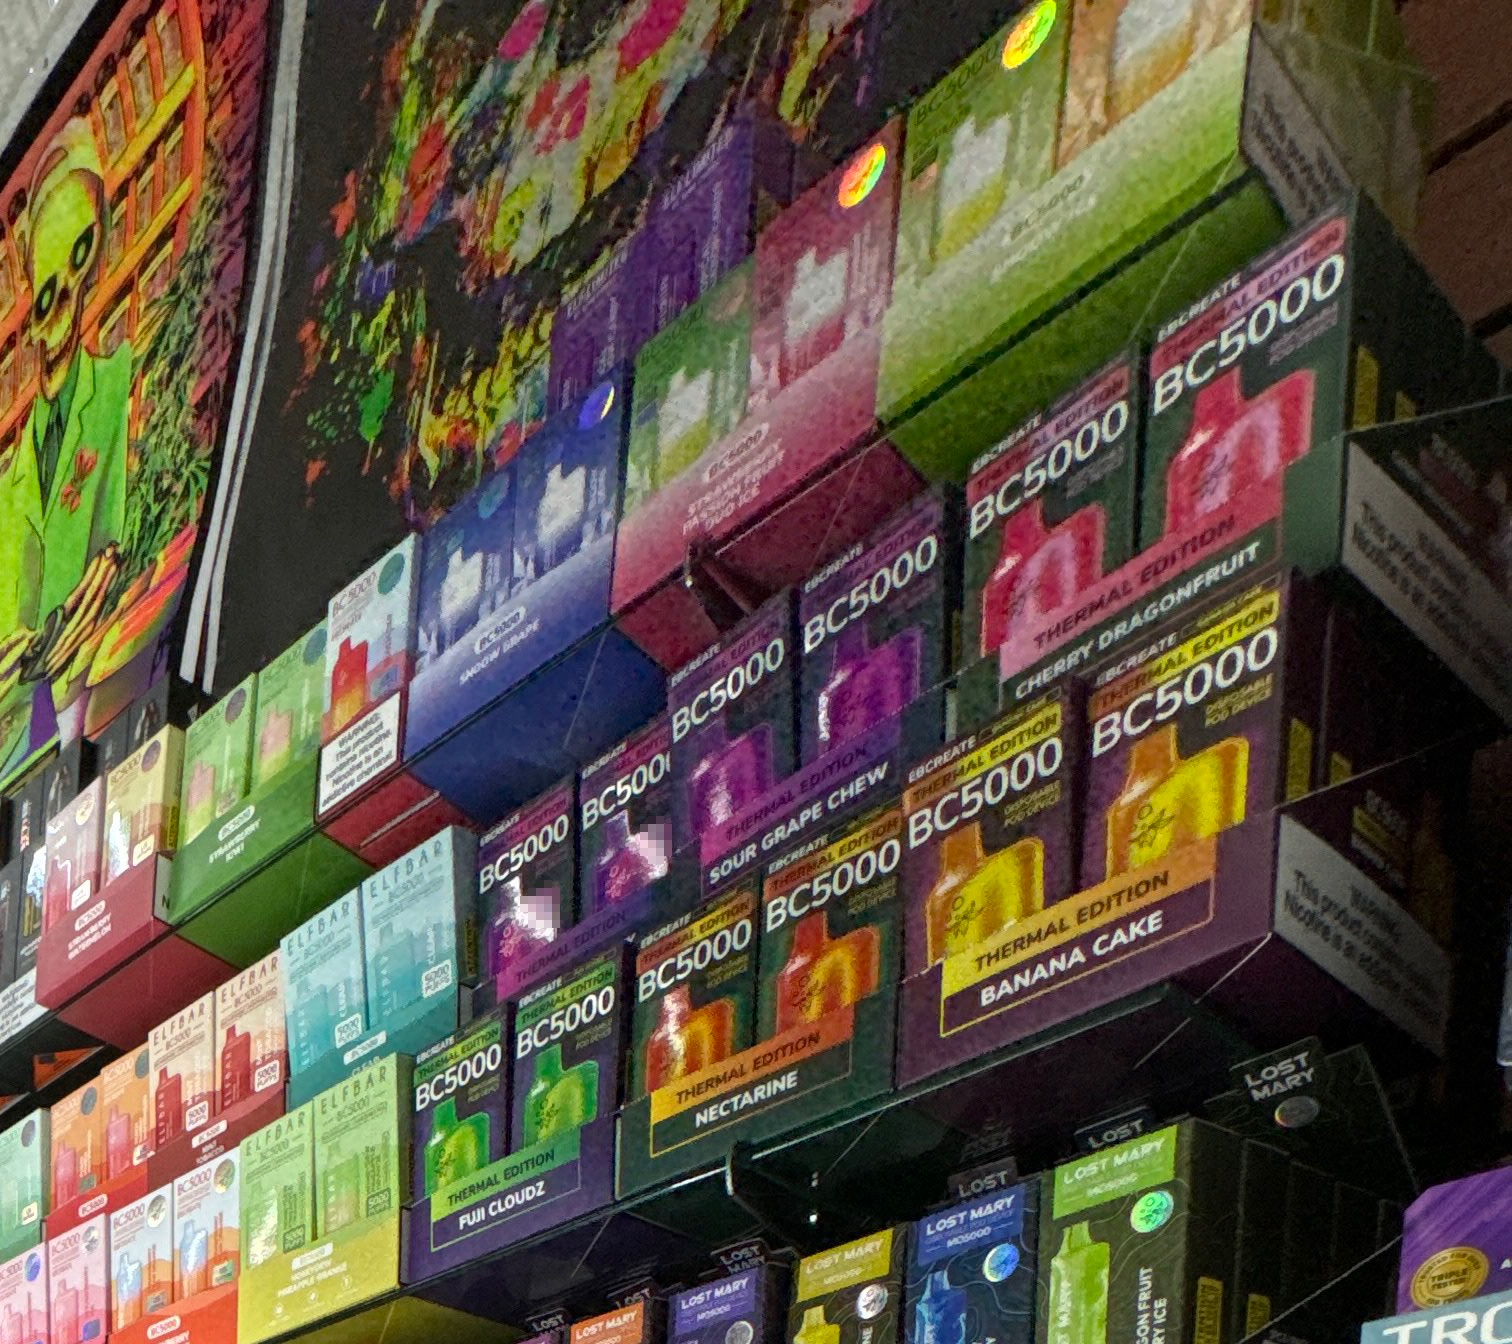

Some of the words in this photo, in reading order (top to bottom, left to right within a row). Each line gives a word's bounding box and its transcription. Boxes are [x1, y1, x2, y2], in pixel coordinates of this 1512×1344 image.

[1153, 253, 1346, 416] BC5000
[969, 400, 1129, 539] BC5000
[803, 534, 938, 655] BC5000
[1015, 638, 1092, 699] CHERRY
[1097, 540, 1260, 650] DRAGONFRUIT
[1033, 579, 1133, 651] THERMAL
[1140, 514, 1235, 585] EDITION
[671, 636, 785, 744] BC5000
[1092, 627, 1278, 759] BC5000
[1095, 633, 1178, 687] EBCREATE
[709, 844, 758, 885] SOUR
[762, 805, 822, 852] GRAPE
[827, 762, 889, 811] CHEW
[907, 736, 1063, 850] BC5000
[974, 917, 1071, 970] THERMAL
[1076, 870, 1170, 927] EDITION
[980, 947, 1087, 1007] BANANA
[1092, 909, 1164, 956] CAKE
[515, 985, 615, 1060] BC5000
[695, 1070, 799, 1128] NECTARINE
[459, 1208, 486, 1230] FUJI
[488, 1180, 546, 1218] CLOUDZ
[925, 1208, 967, 1236] LOST
[969, 1194, 1016, 1224] MARY
[1062, 1156, 1111, 1184] LOST
[1112, 1138, 1165, 1167] MARY
